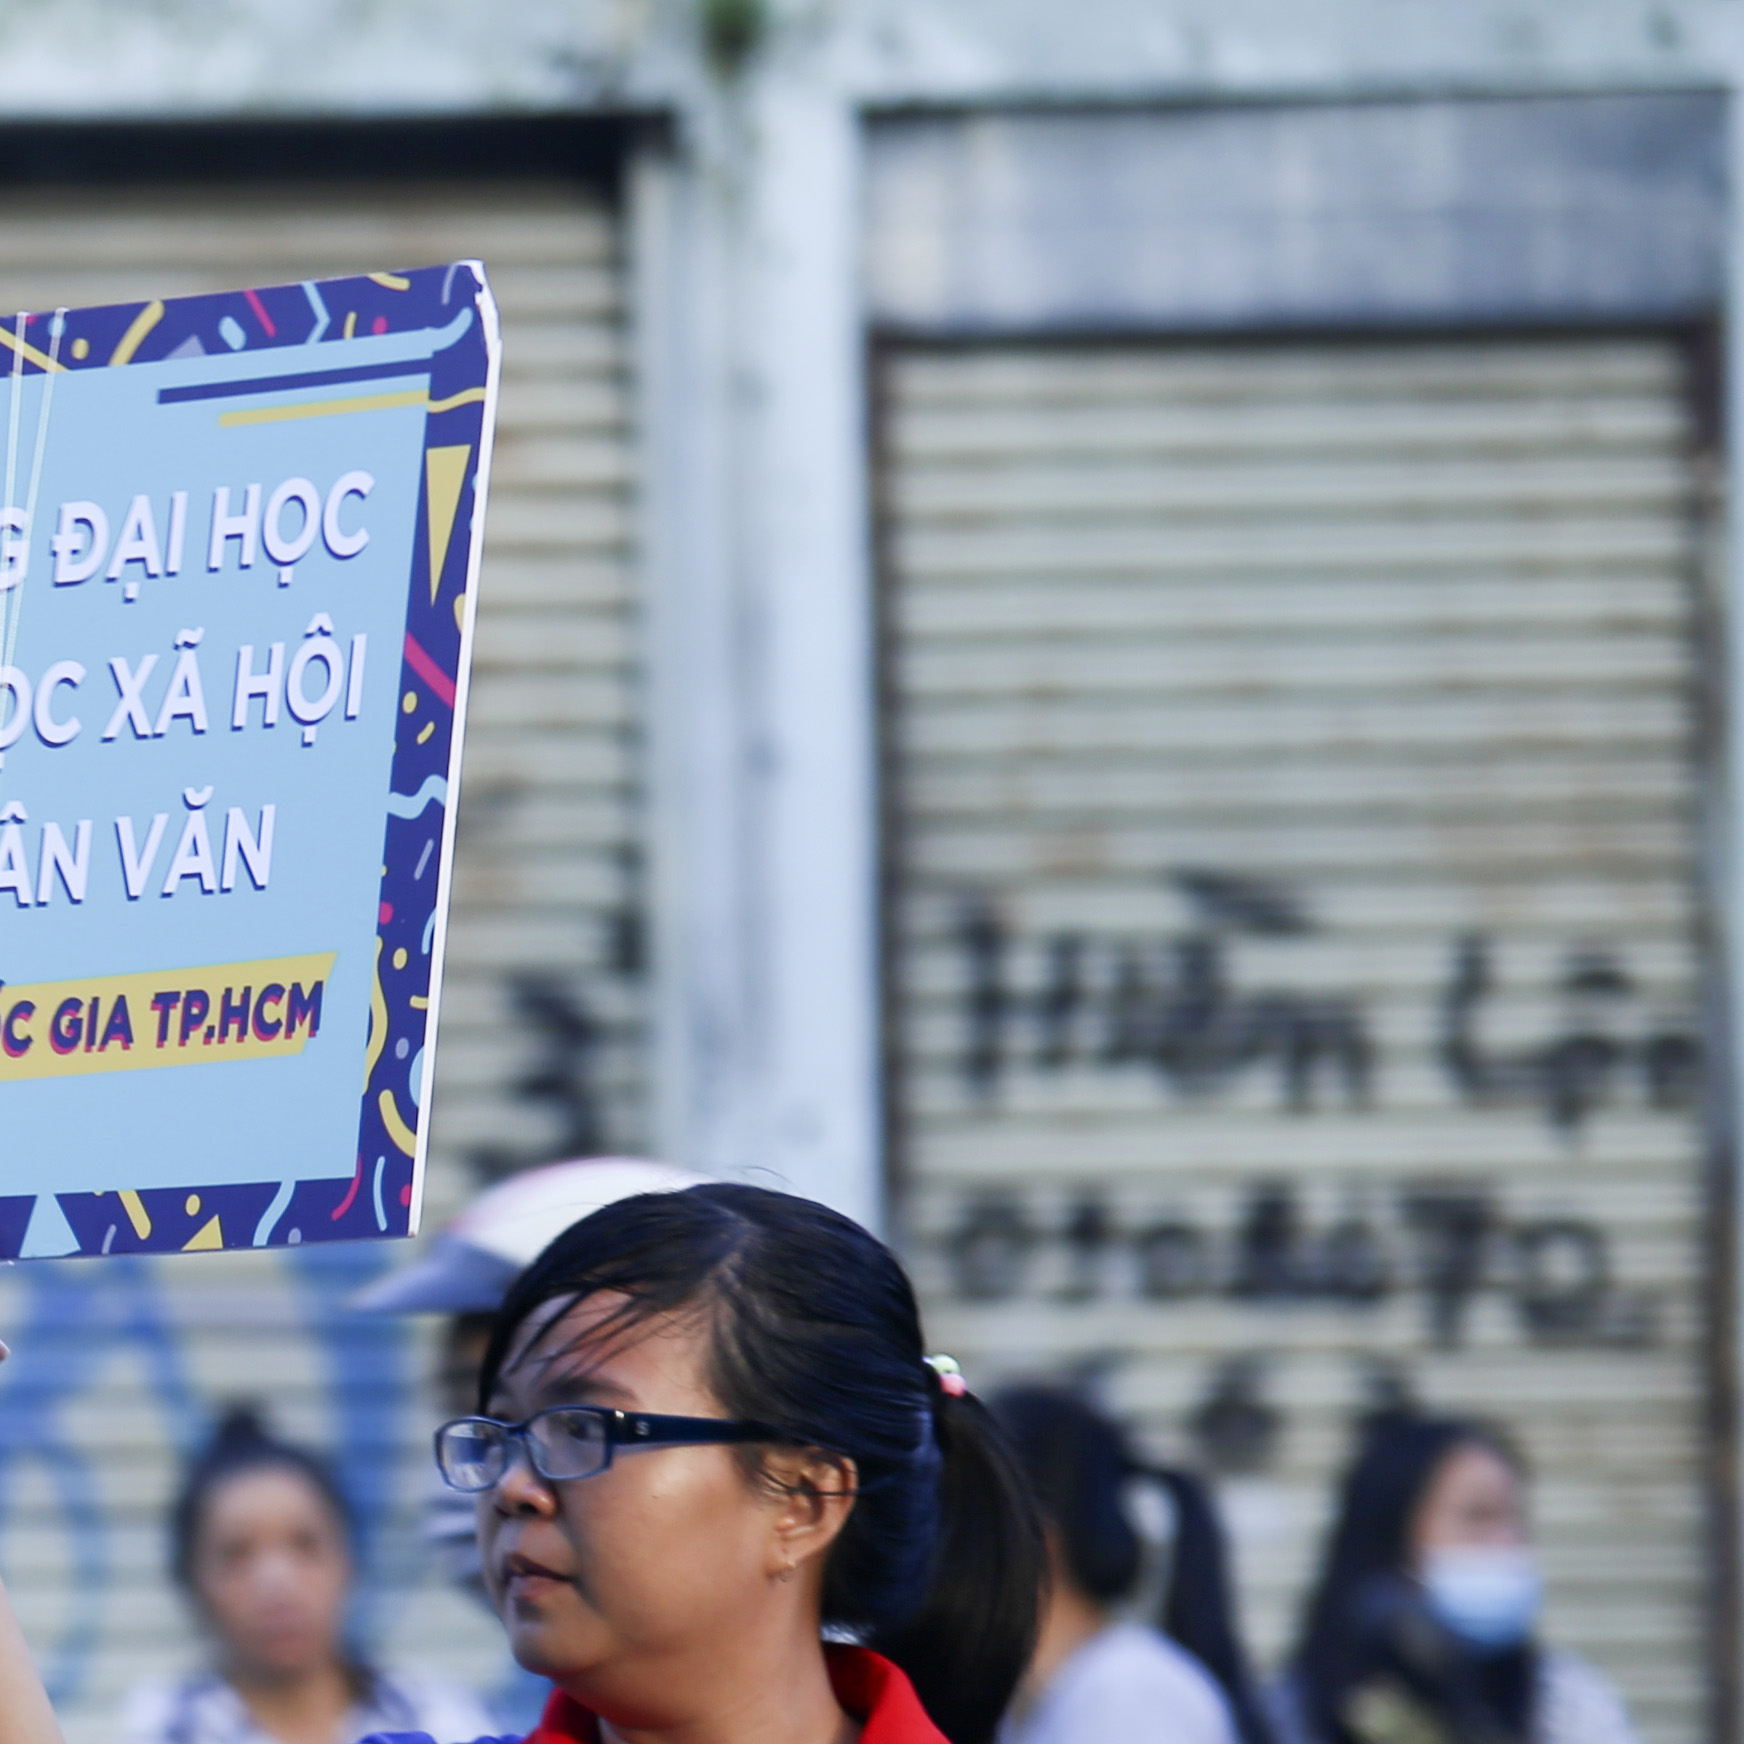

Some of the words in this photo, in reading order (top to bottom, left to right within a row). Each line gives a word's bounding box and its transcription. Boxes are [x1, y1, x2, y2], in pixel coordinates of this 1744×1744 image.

[51, 490, 188, 603] ĐẠI
[206, 470, 375, 588] HỌC
[100, 626, 209, 743] XÃ
[230, 612, 367, 747] HỘI
[114, 785, 276, 900] VĂN
[48, 994, 134, 1055] GIA
[150, 980, 324, 1048] TP.HCM
